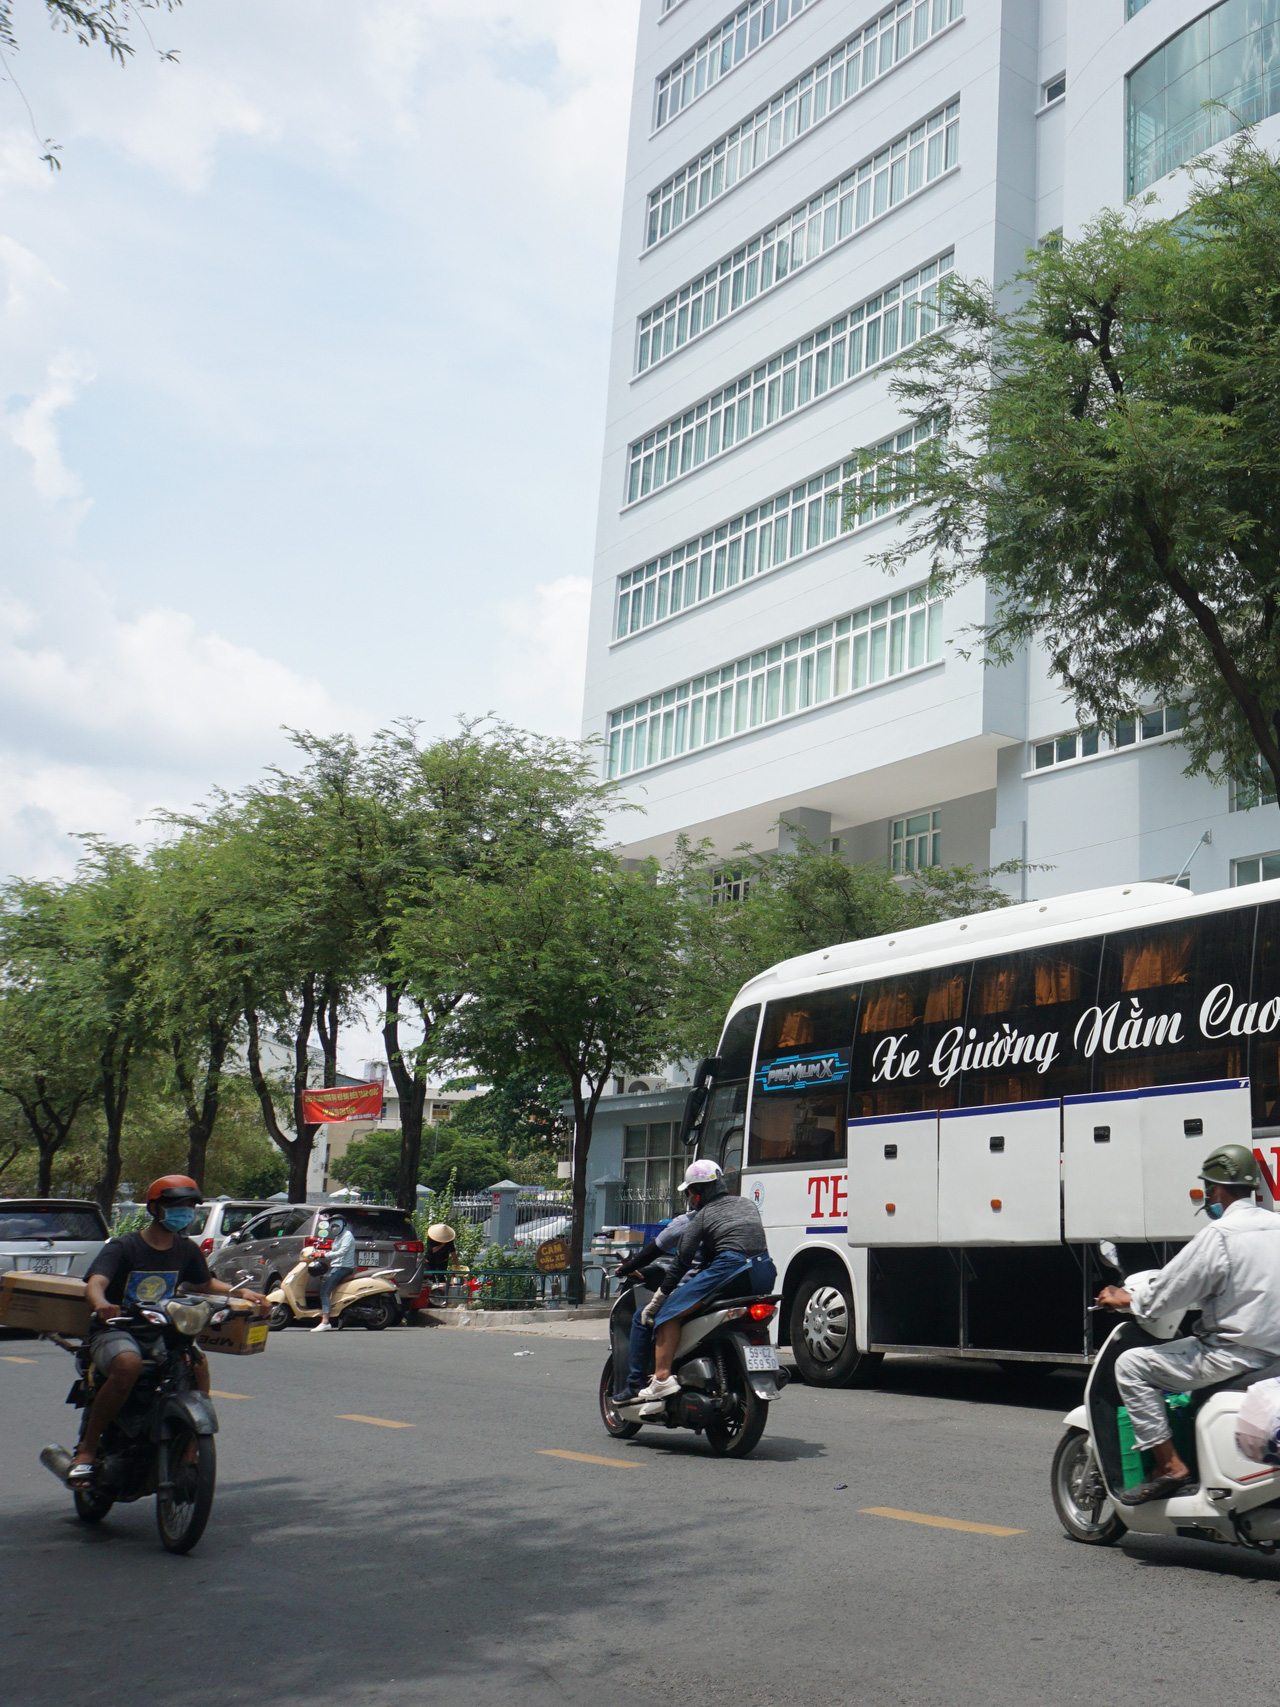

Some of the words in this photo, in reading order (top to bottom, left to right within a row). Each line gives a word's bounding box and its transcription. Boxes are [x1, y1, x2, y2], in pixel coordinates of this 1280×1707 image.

[871, 1033, 921, 1083] Xe
[928, 1022, 1060, 1088] Giường
[1073, 997, 1184, 1058] Nằm
